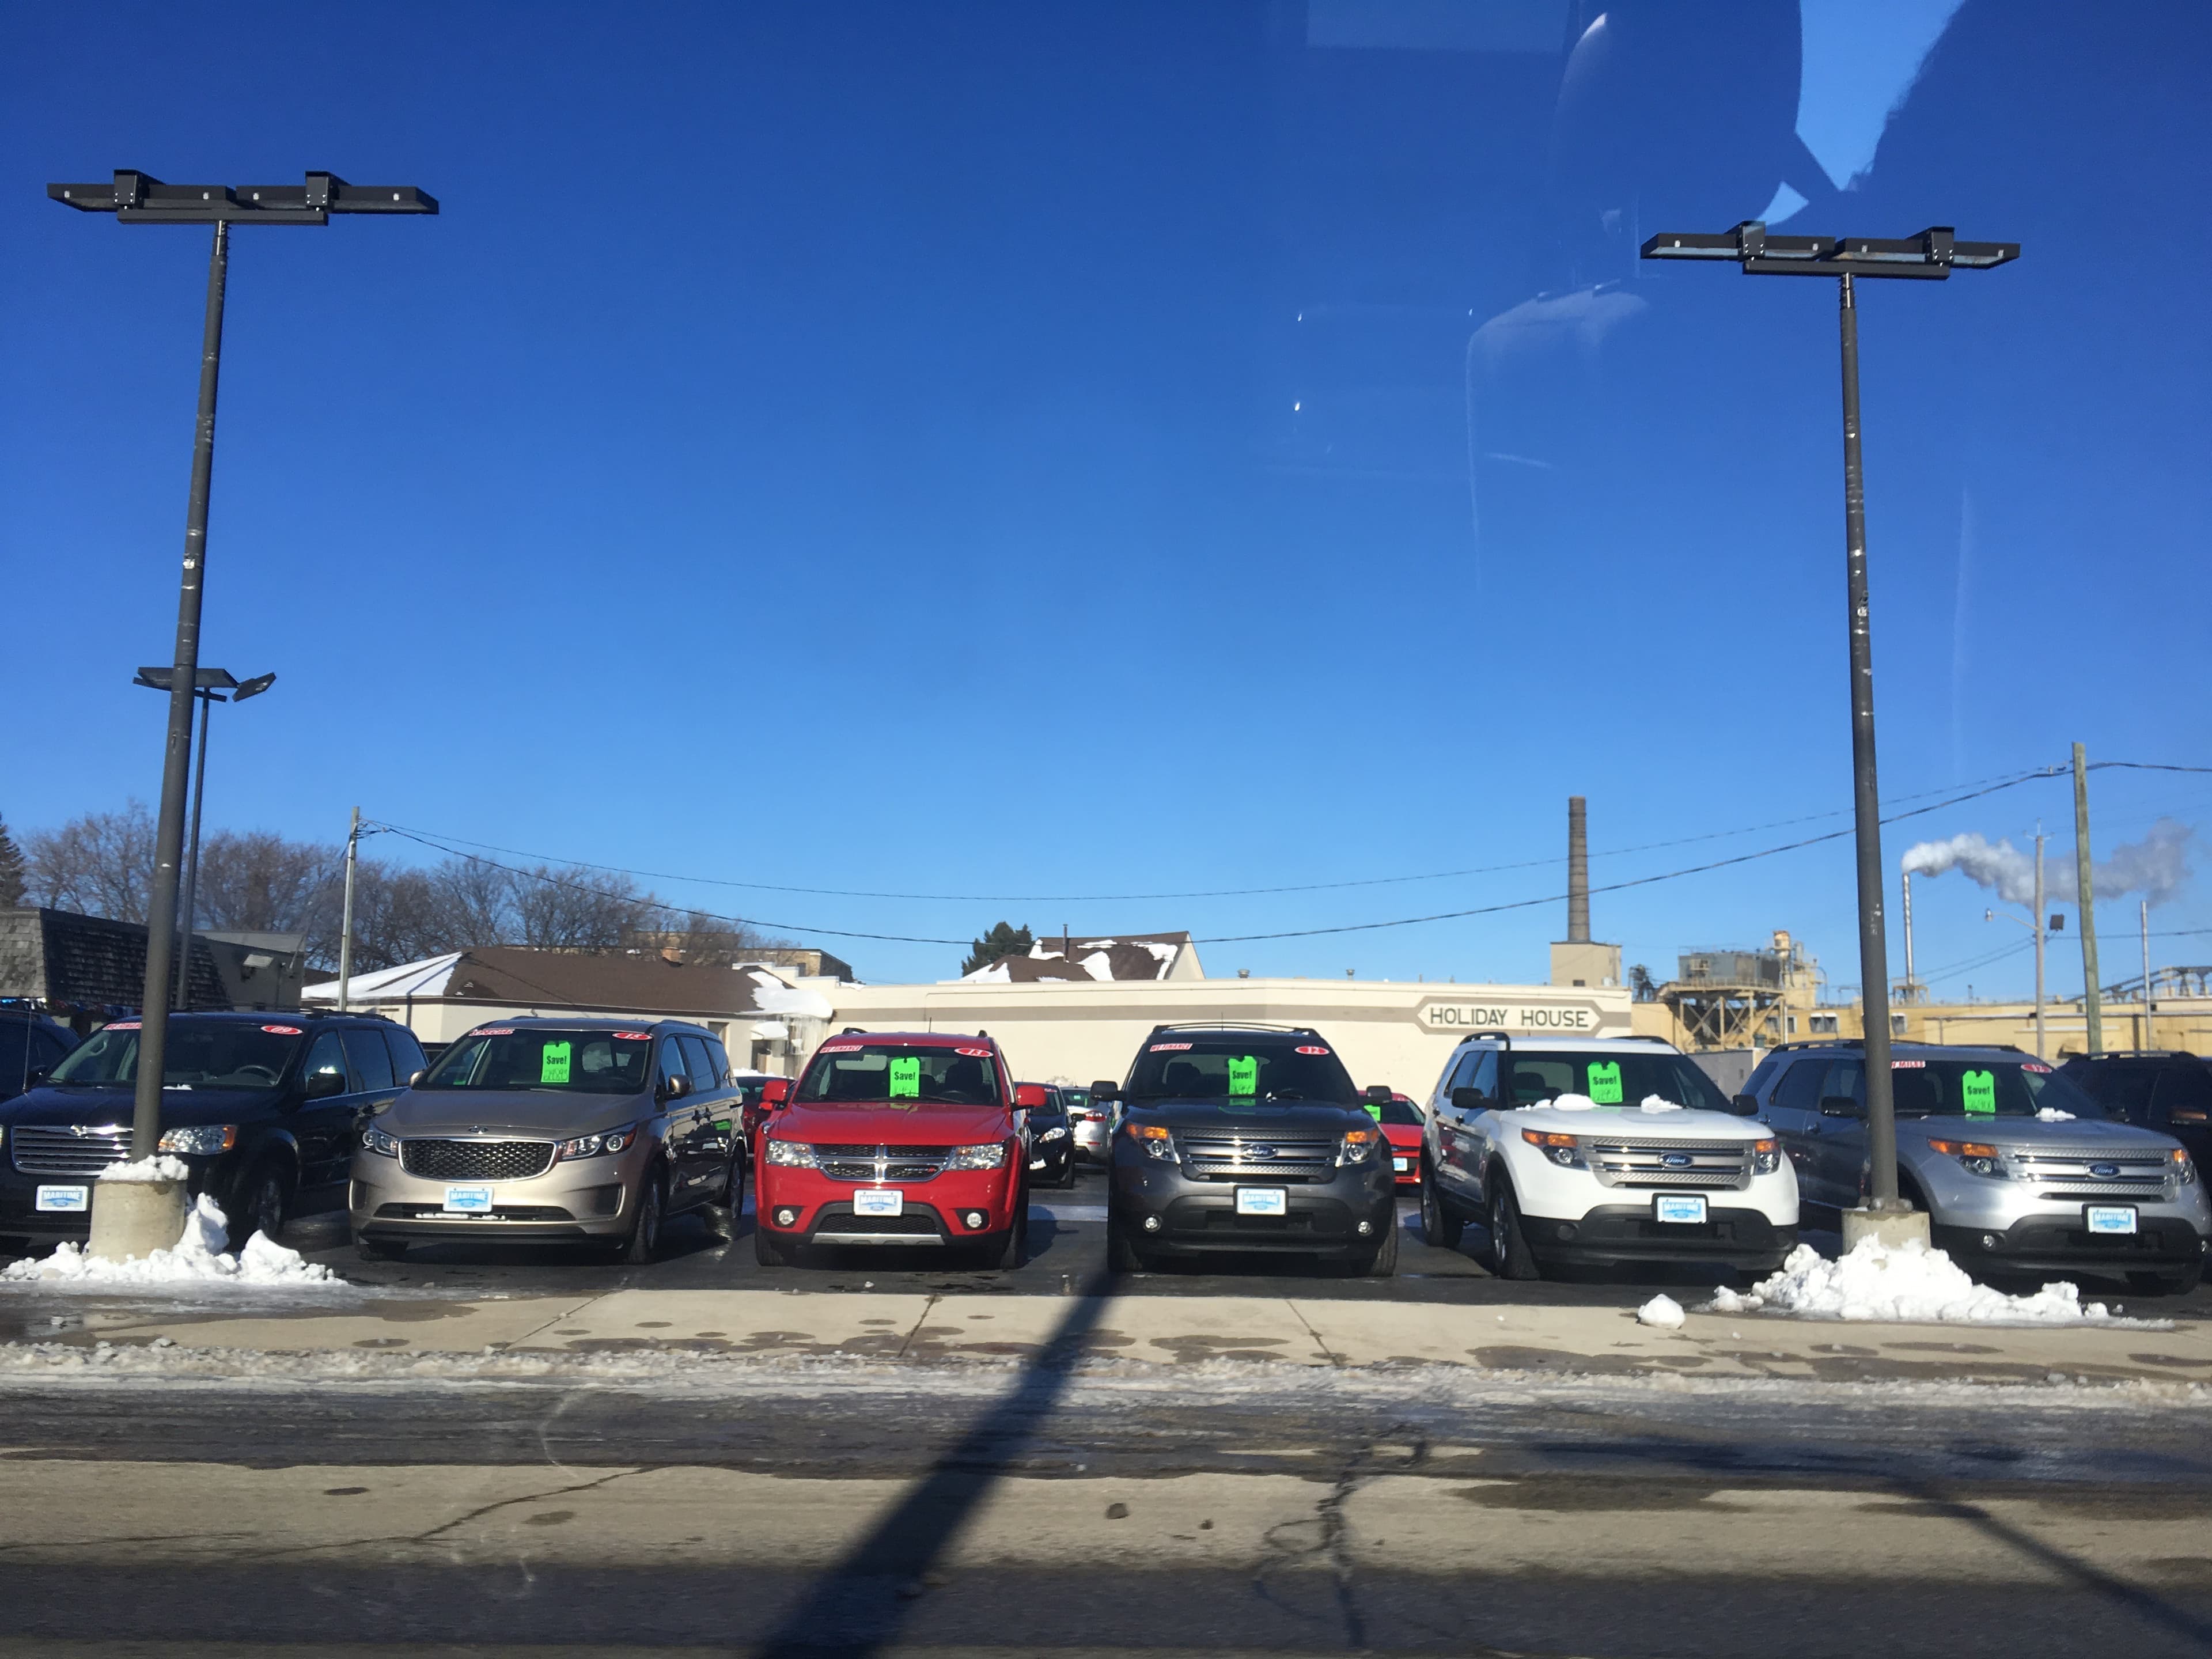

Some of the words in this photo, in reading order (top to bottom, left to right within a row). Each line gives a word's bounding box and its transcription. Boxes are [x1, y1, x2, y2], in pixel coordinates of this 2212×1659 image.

[1430, 1007, 1508, 1025] HOLIDAY
[1521, 1010, 1589, 1027] HOUSE
[1308, 1046, 1320, 1054] 12
[546, 1055, 567, 1065] Save!
[894, 1071, 916, 1081] Save!
[1232, 1070, 1252, 1080] Save!
[1593, 1075, 1617, 1085] Save!
[1967, 1085, 1990, 1095] Save!
[43, 1192, 81, 1201] MARITIME
[450, 1192, 486, 1201] MARITIME
[860, 1196, 896, 1205] MARITIME
[2094, 1213, 2130, 1222] MARITIME
